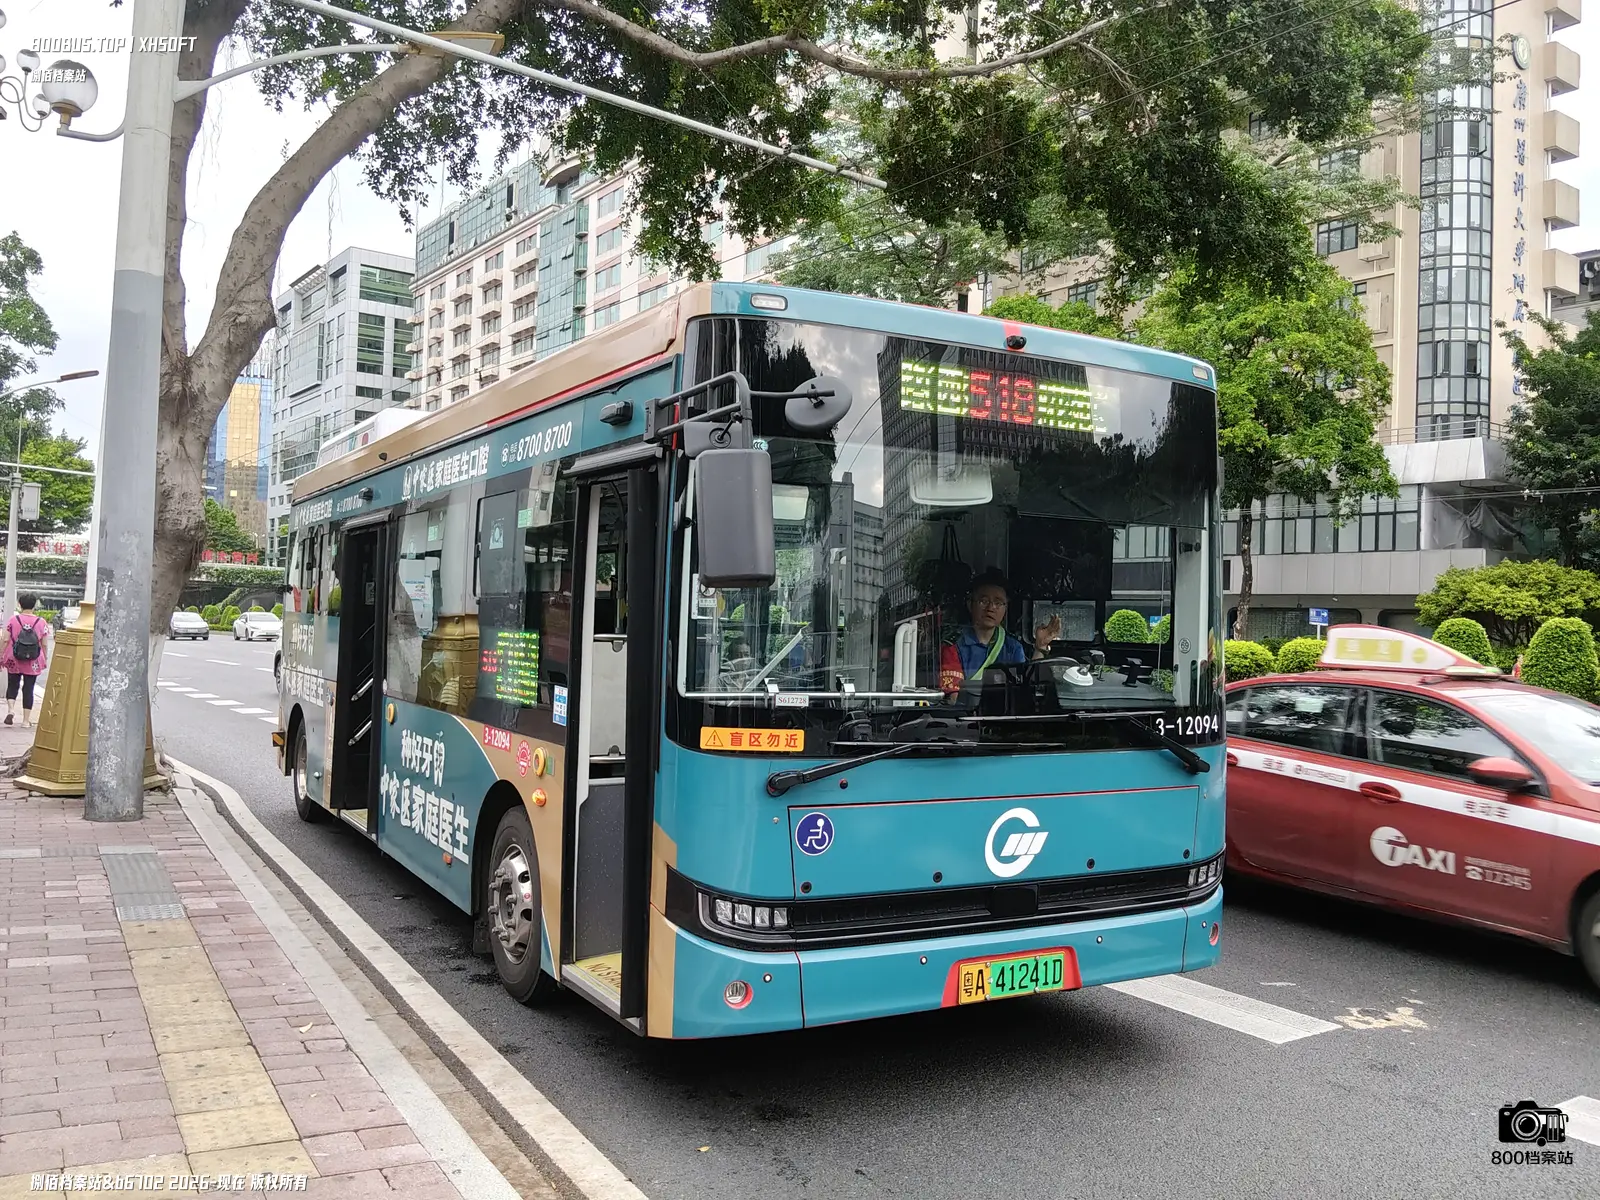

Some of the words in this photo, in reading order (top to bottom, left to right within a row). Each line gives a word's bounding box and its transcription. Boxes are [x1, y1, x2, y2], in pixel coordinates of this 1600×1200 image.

[517, 431, 543, 462] 8700
[543, 420, 573, 451] 8700
[777, 695, 808, 706] S612728
[1155, 714, 1219, 736] 3-12094
[484, 726, 511, 751] 3-12094
[729, 731, 799, 749] 盲区勿近
[1369, 826, 1457, 875] TAXI
